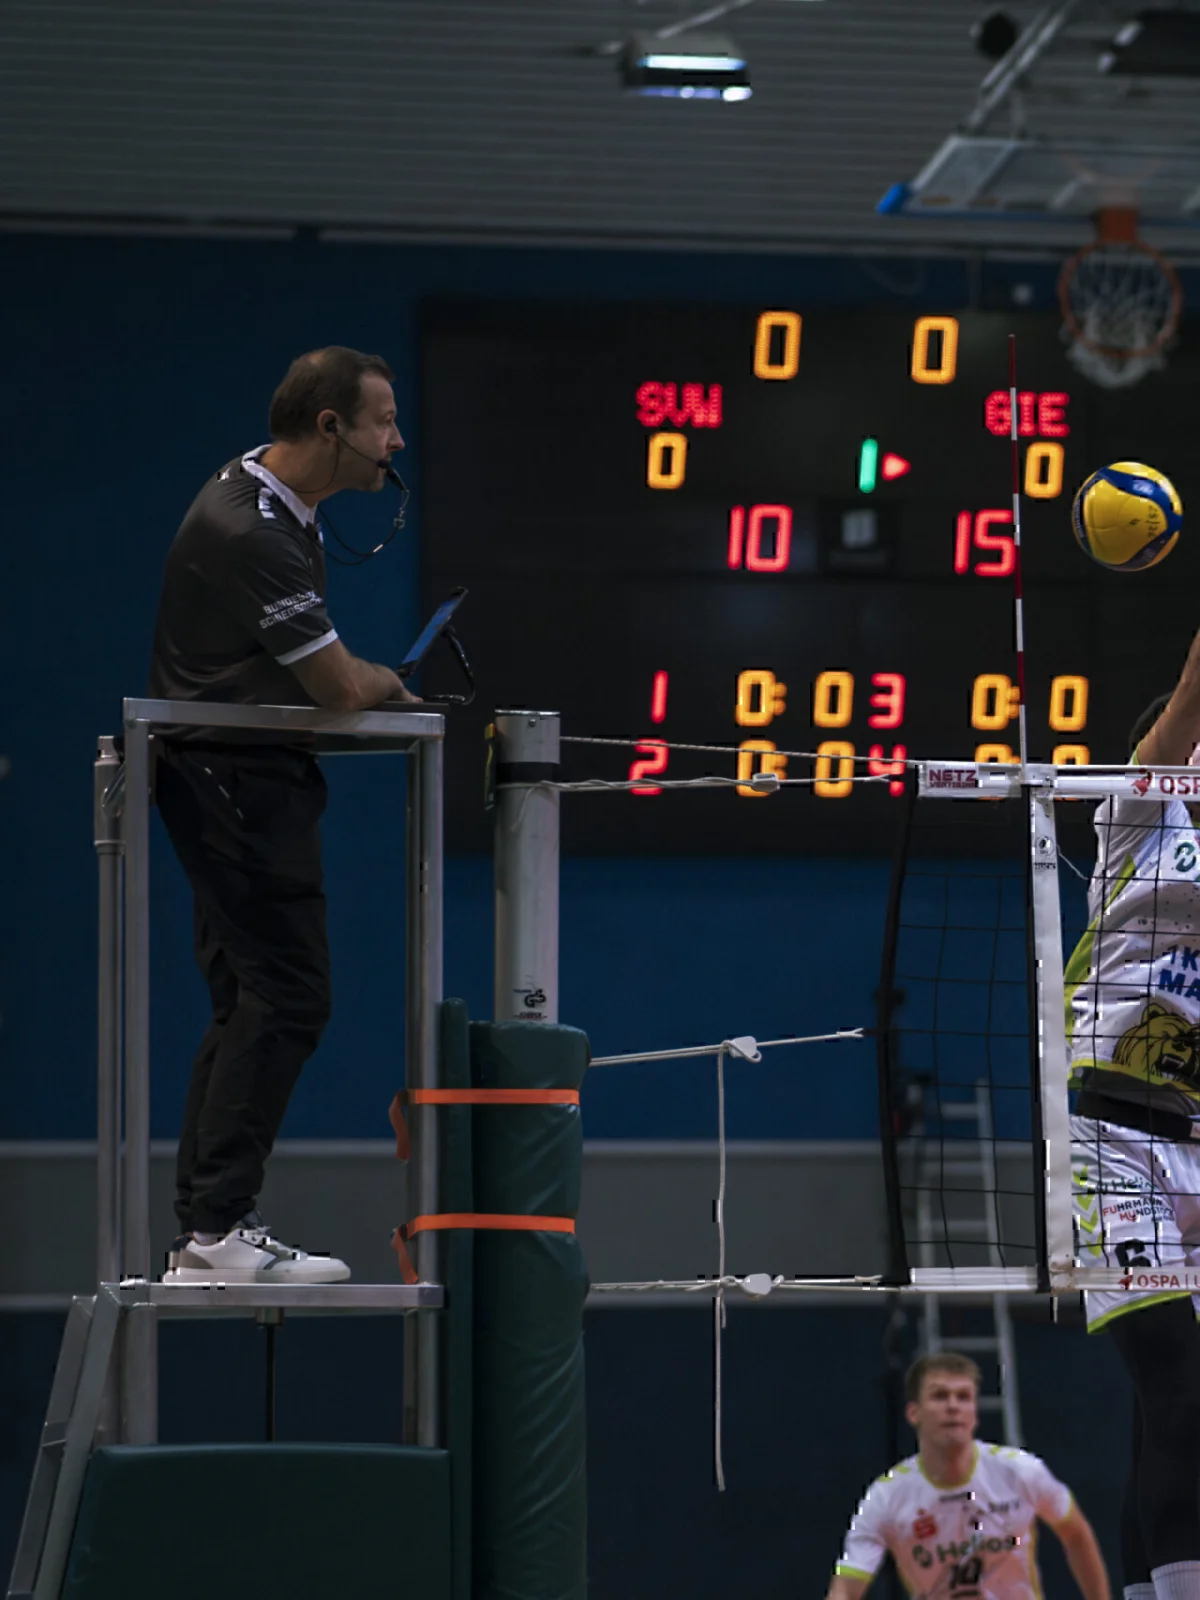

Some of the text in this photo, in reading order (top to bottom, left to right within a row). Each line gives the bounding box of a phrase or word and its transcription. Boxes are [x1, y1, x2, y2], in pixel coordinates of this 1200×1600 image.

[753, 311, 801, 380] 0
[911, 315, 959, 385] 0
[647, 432, 688, 490] 0
[1024, 441, 1065, 499] 0
[727, 503, 793, 573] 10
[954, 508, 1017, 577] 15
[651, 670, 669, 723] 1
[867, 672, 906, 729] 3
[629, 738, 669, 796] 2
[867, 744, 907, 797] 4
[929, 769, 976, 781] NETZ
[1102, 1198, 1163, 1217] FUHRMANN
[1137, 1275, 1180, 1288] OSPA
